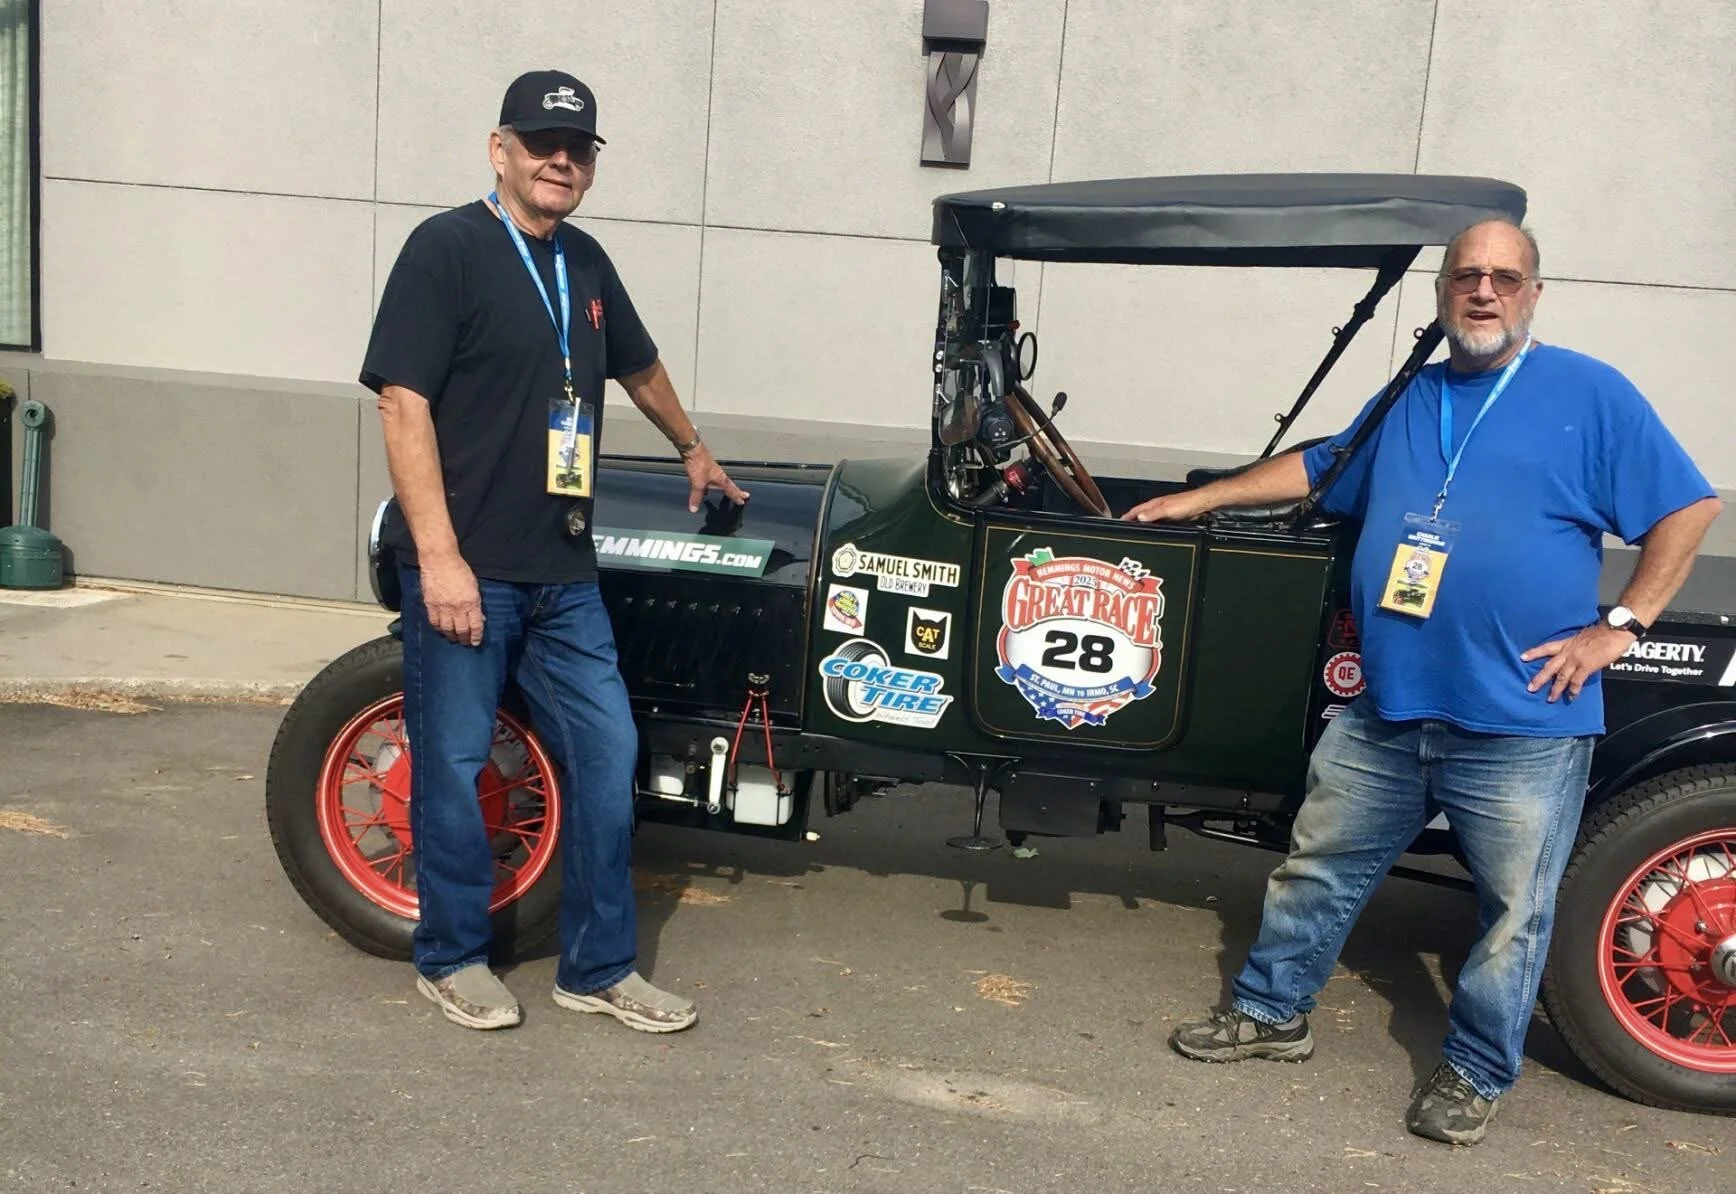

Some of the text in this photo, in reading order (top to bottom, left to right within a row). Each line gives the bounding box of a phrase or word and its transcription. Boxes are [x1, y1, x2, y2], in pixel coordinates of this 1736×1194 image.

[591, 535, 762, 569] EMMINGS.COM
[858, 554, 958, 585] SAMUEL SMITH
[1036, 563, 1136, 590] HEMMINGS MOTOR NEWS
[1412, 562, 1423, 571] 28
[880, 576, 927, 594] OLD BREWERY
[1074, 576, 1098, 586] 2025
[1007, 578, 1159, 645] GREAT RACE
[916, 626, 940, 643] CAT
[918, 642, 937, 651] SCALE
[1041, 630, 1115, 674] 28
[823, 658, 938, 692] COKER
[1610, 662, 1704, 677] Let's Drive Together
[1030, 674, 1039, 684] ST.
[1040, 679, 1060, 693] PAUL,
[1087, 687, 1109, 697] IRMO,
[1110, 684, 1119, 693] SC
[862, 686, 946, 713] TIRE
